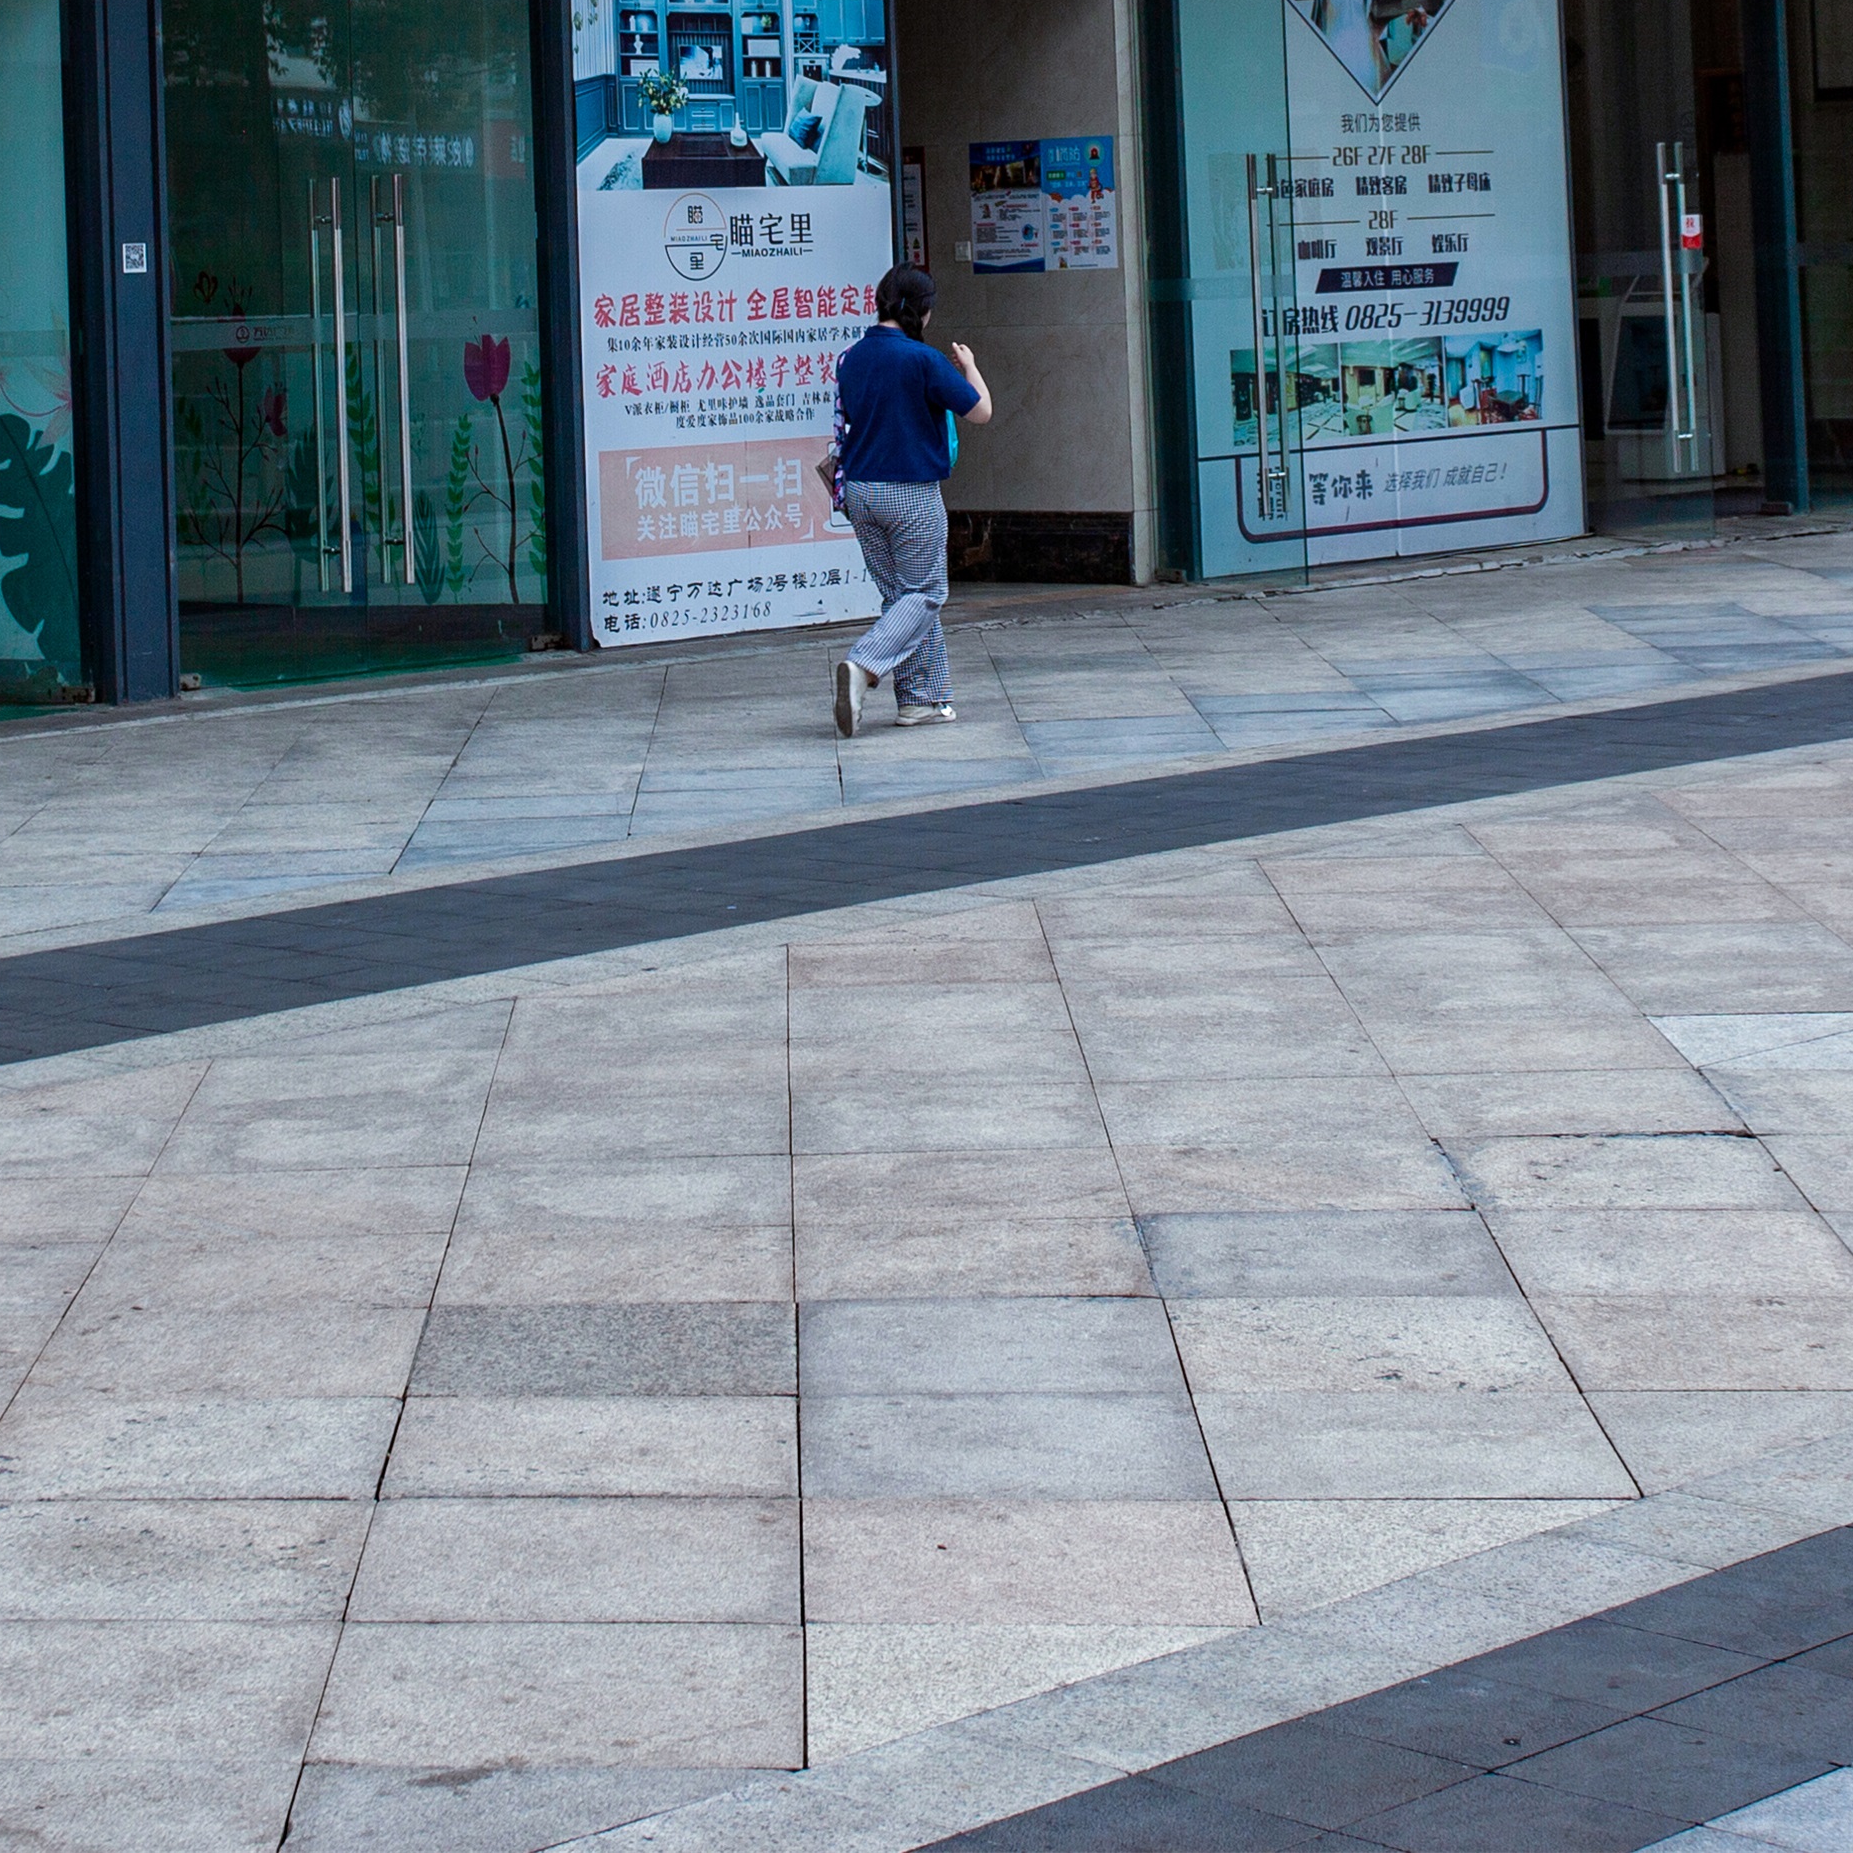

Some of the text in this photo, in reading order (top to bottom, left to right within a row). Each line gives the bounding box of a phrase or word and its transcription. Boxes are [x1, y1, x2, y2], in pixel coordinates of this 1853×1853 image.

[1341, 112, 1421, 134] 我们为您提供
[1332, 145, 1431, 167] 26F 27F 28F
[1267, 177, 1334, 199] 色家庭房
[729, 212, 814, 246] 瞄宅里
[1368, 209, 1399, 229] 28F
[1391, 268, 1435, 286] 用心服务
[594, 284, 877, 329] 家居整装设计 全屋智能定制
[1345, 296, 1510, 331] 0825-3139999
[635, 457, 803, 509] 微信扫一扫
[1309, 470, 1373, 506] 等你来
[1383, 467, 1440, 493] 选择我们
[636, 503, 804, 543] 关注瞄宅里公众号
